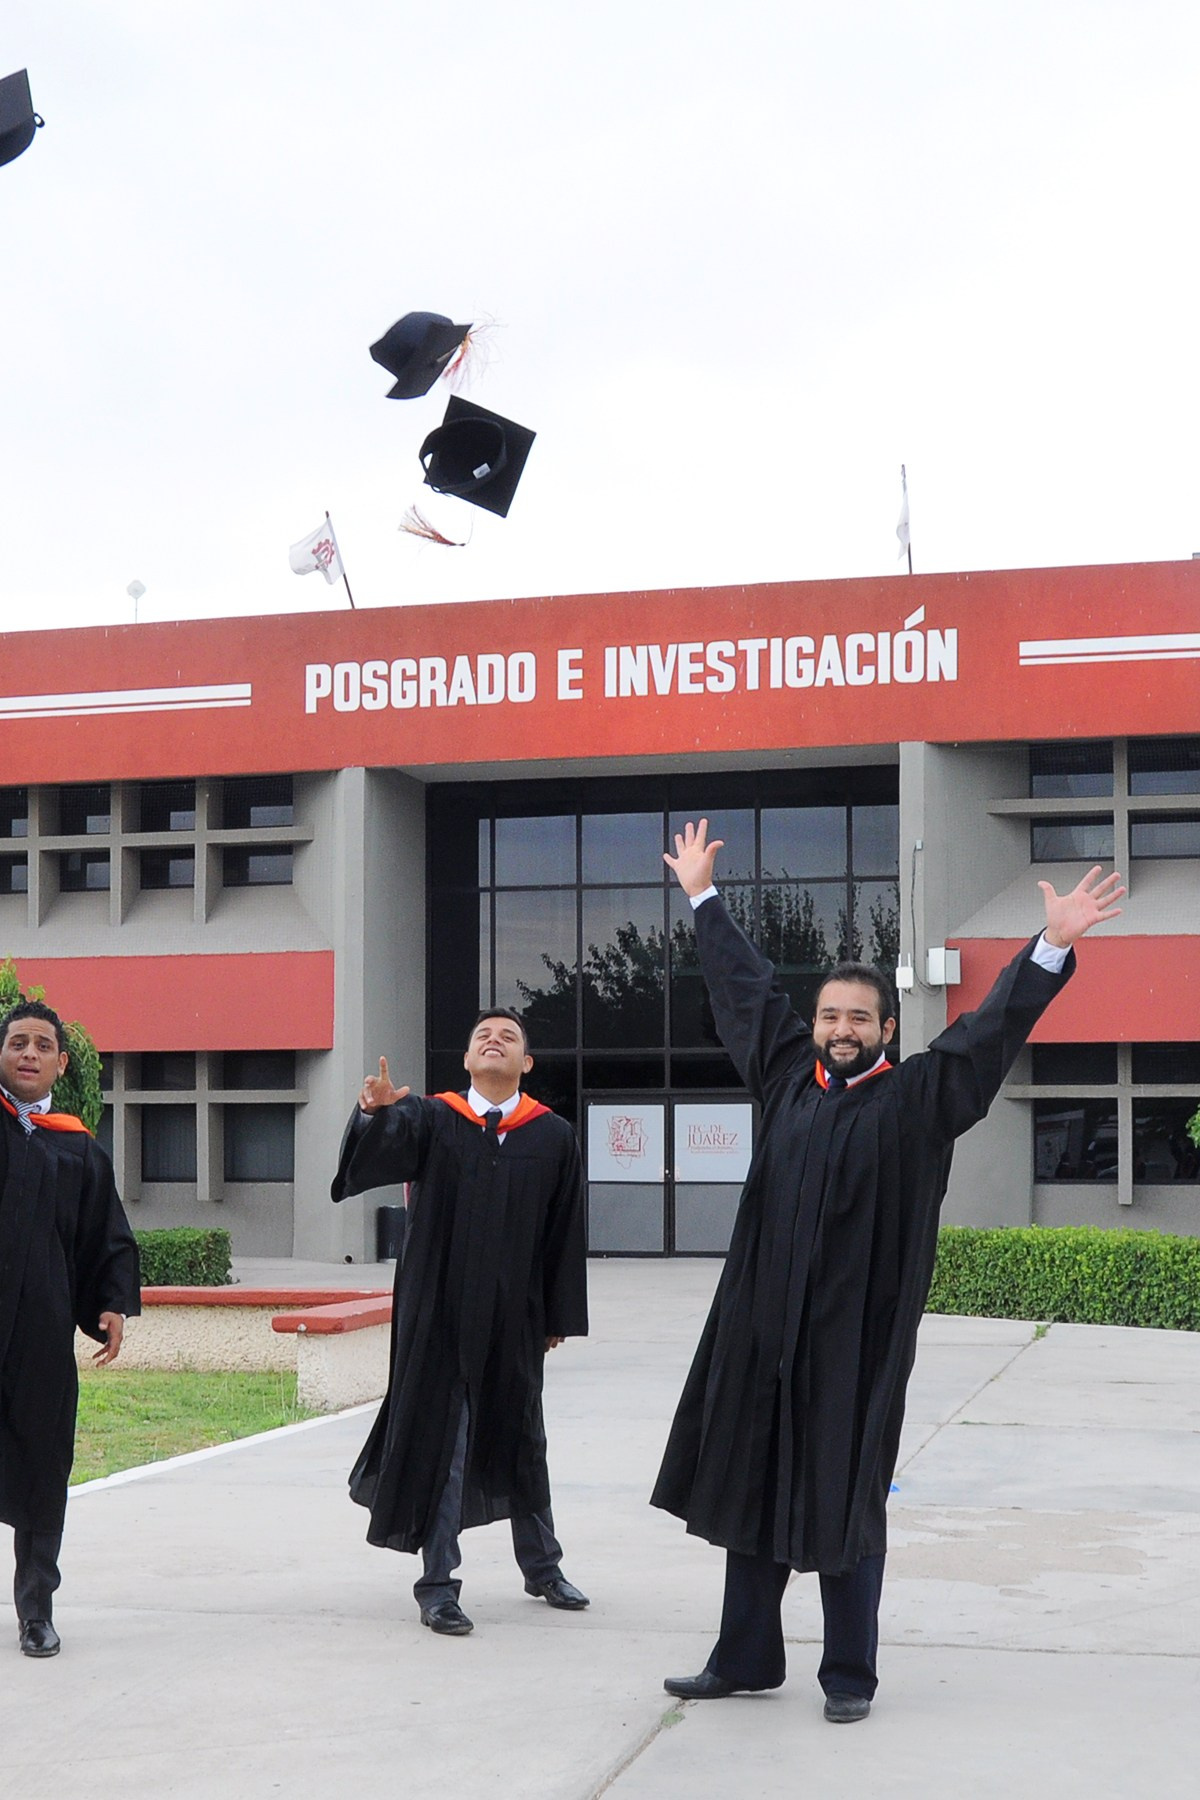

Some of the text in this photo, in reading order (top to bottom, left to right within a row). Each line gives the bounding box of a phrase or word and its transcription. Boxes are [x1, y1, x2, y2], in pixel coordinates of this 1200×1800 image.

[305, 604, 959, 715] POSGRADO E INVESTIGACIÓN
